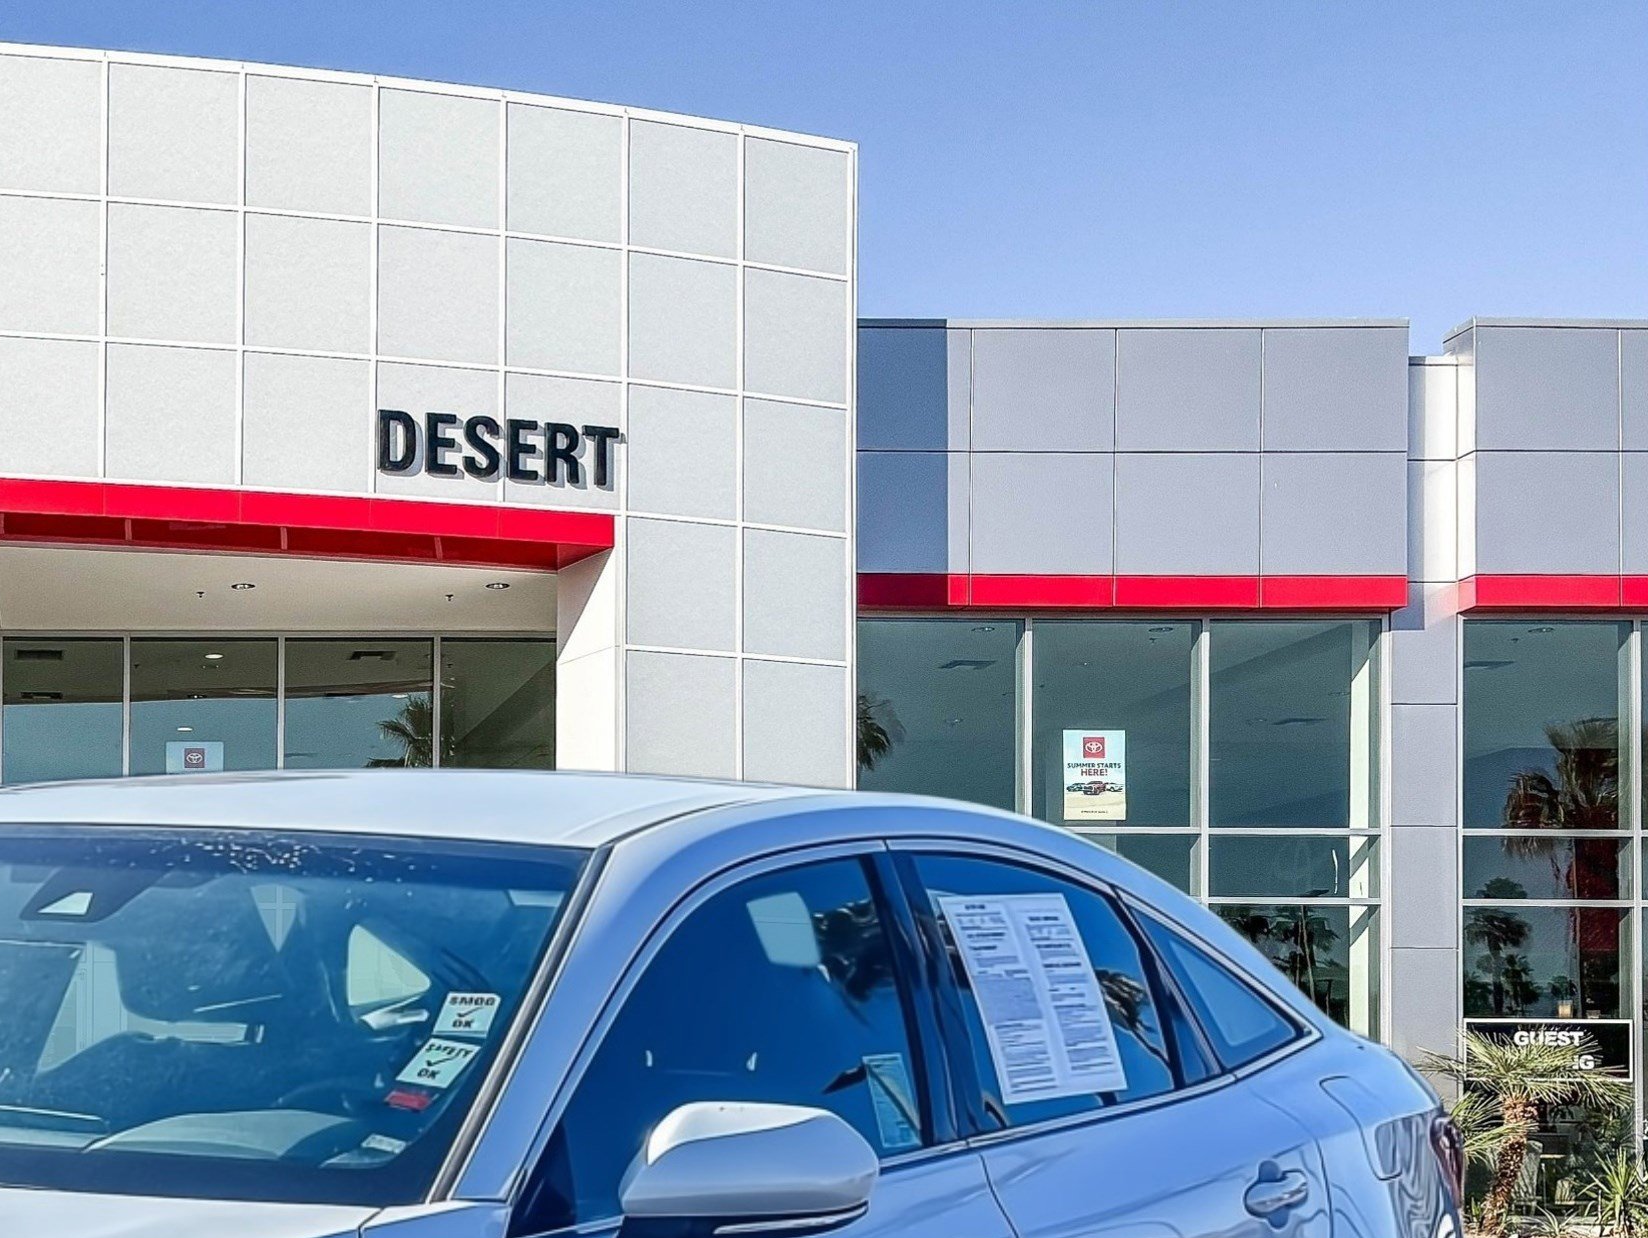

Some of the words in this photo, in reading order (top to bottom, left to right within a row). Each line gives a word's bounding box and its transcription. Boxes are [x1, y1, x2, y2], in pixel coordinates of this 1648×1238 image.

[377, 409, 620, 487] DESERT
[452, 1019, 474, 1029] OK
[1514, 1030, 1584, 1047] GUEST
[424, 1043, 474, 1059] SAFETY
[417, 1068, 441, 1080] OK
